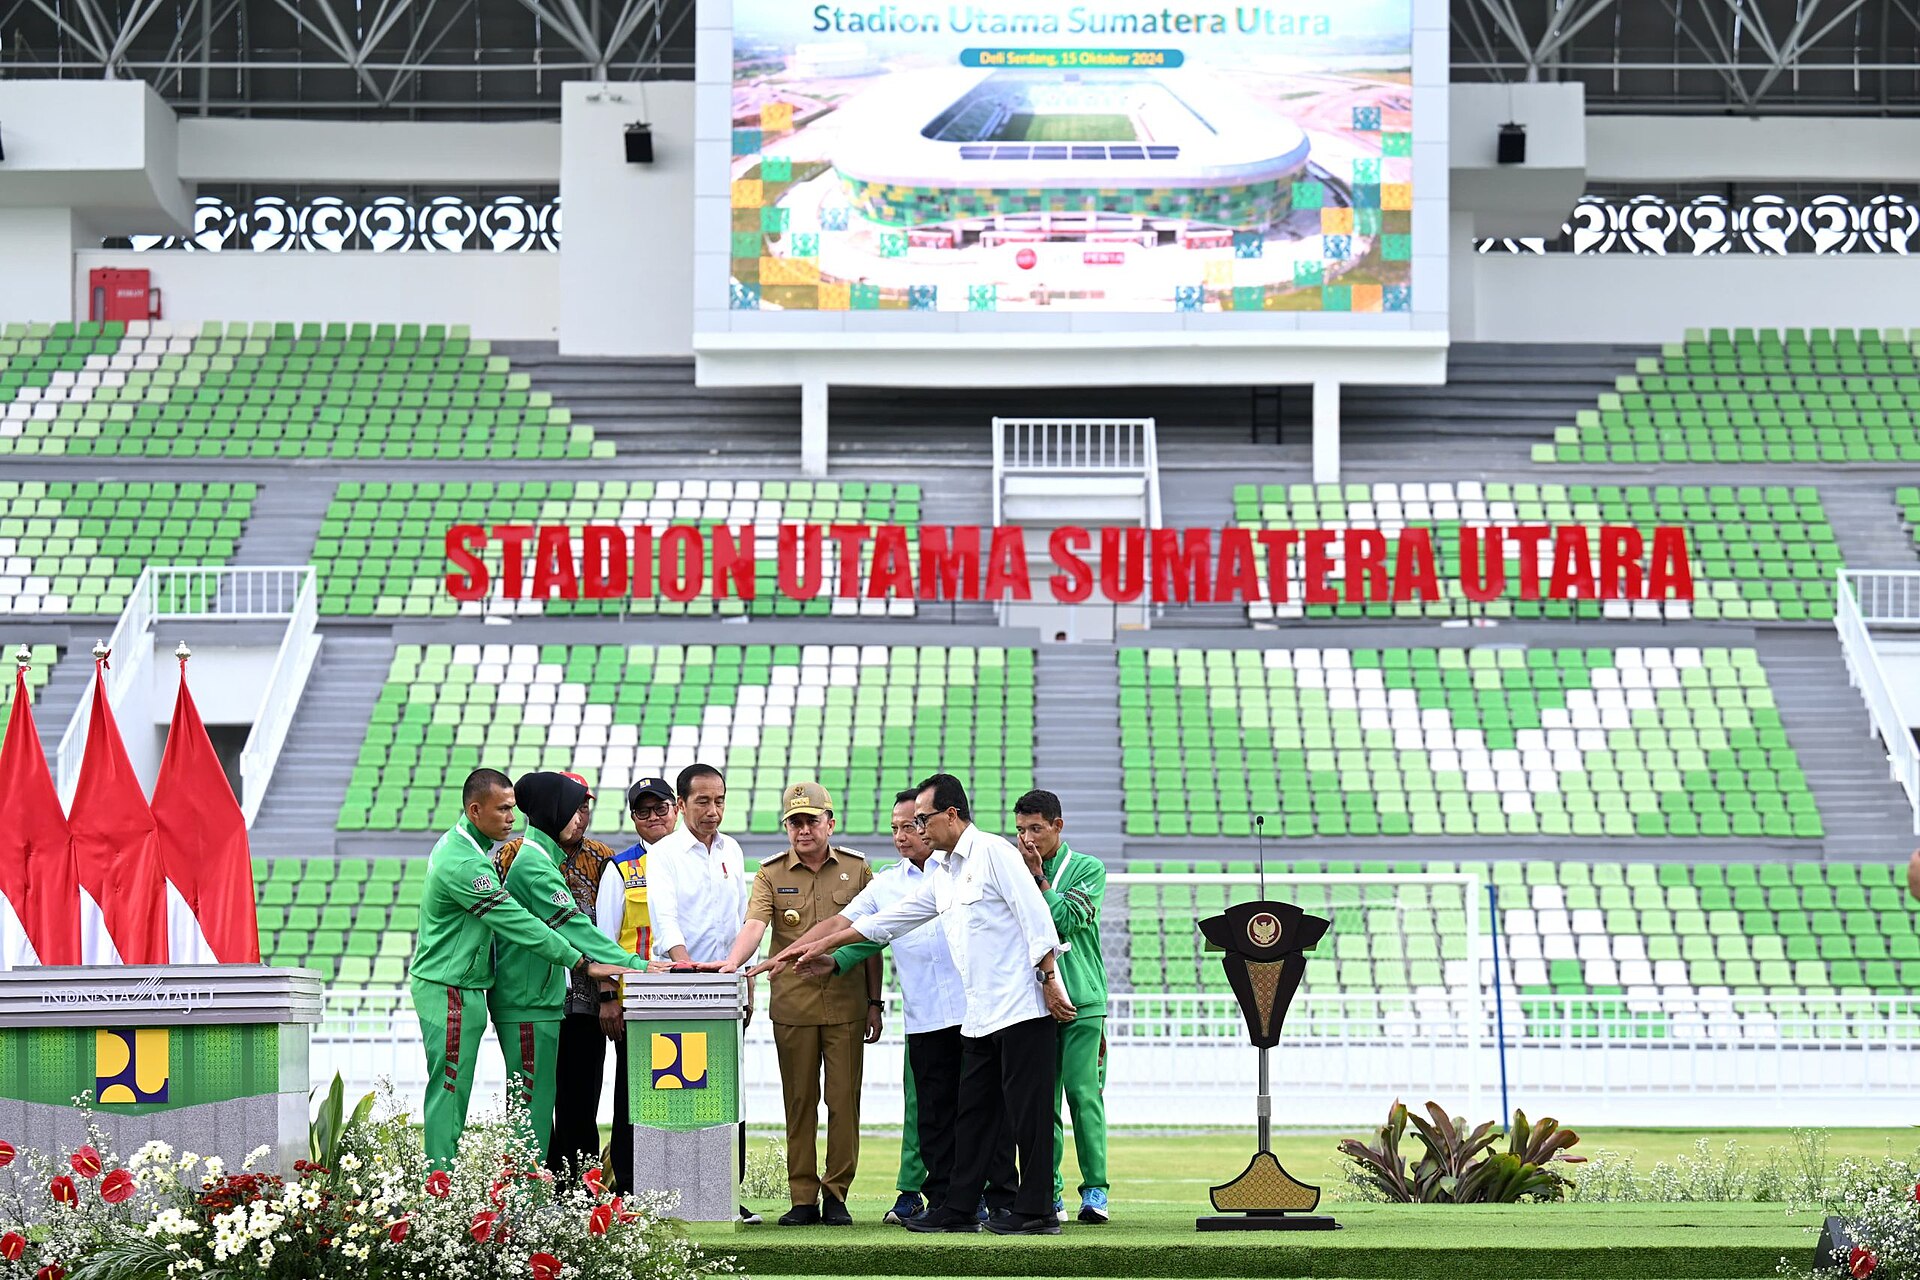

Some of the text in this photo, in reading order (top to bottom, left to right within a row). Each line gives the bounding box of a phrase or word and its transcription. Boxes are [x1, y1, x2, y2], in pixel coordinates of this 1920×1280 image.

[813, 4, 1330, 35] Stadion Utama Sumatera Utara
[979, 52, 1004, 65] Deli
[1061, 52, 1076, 65] 15
[1079, 52, 1130, 65] Oktober
[1132, 52, 1164, 65] 2024
[445, 524, 1693, 603] STADION UTAMA SUMATERA UTARA
